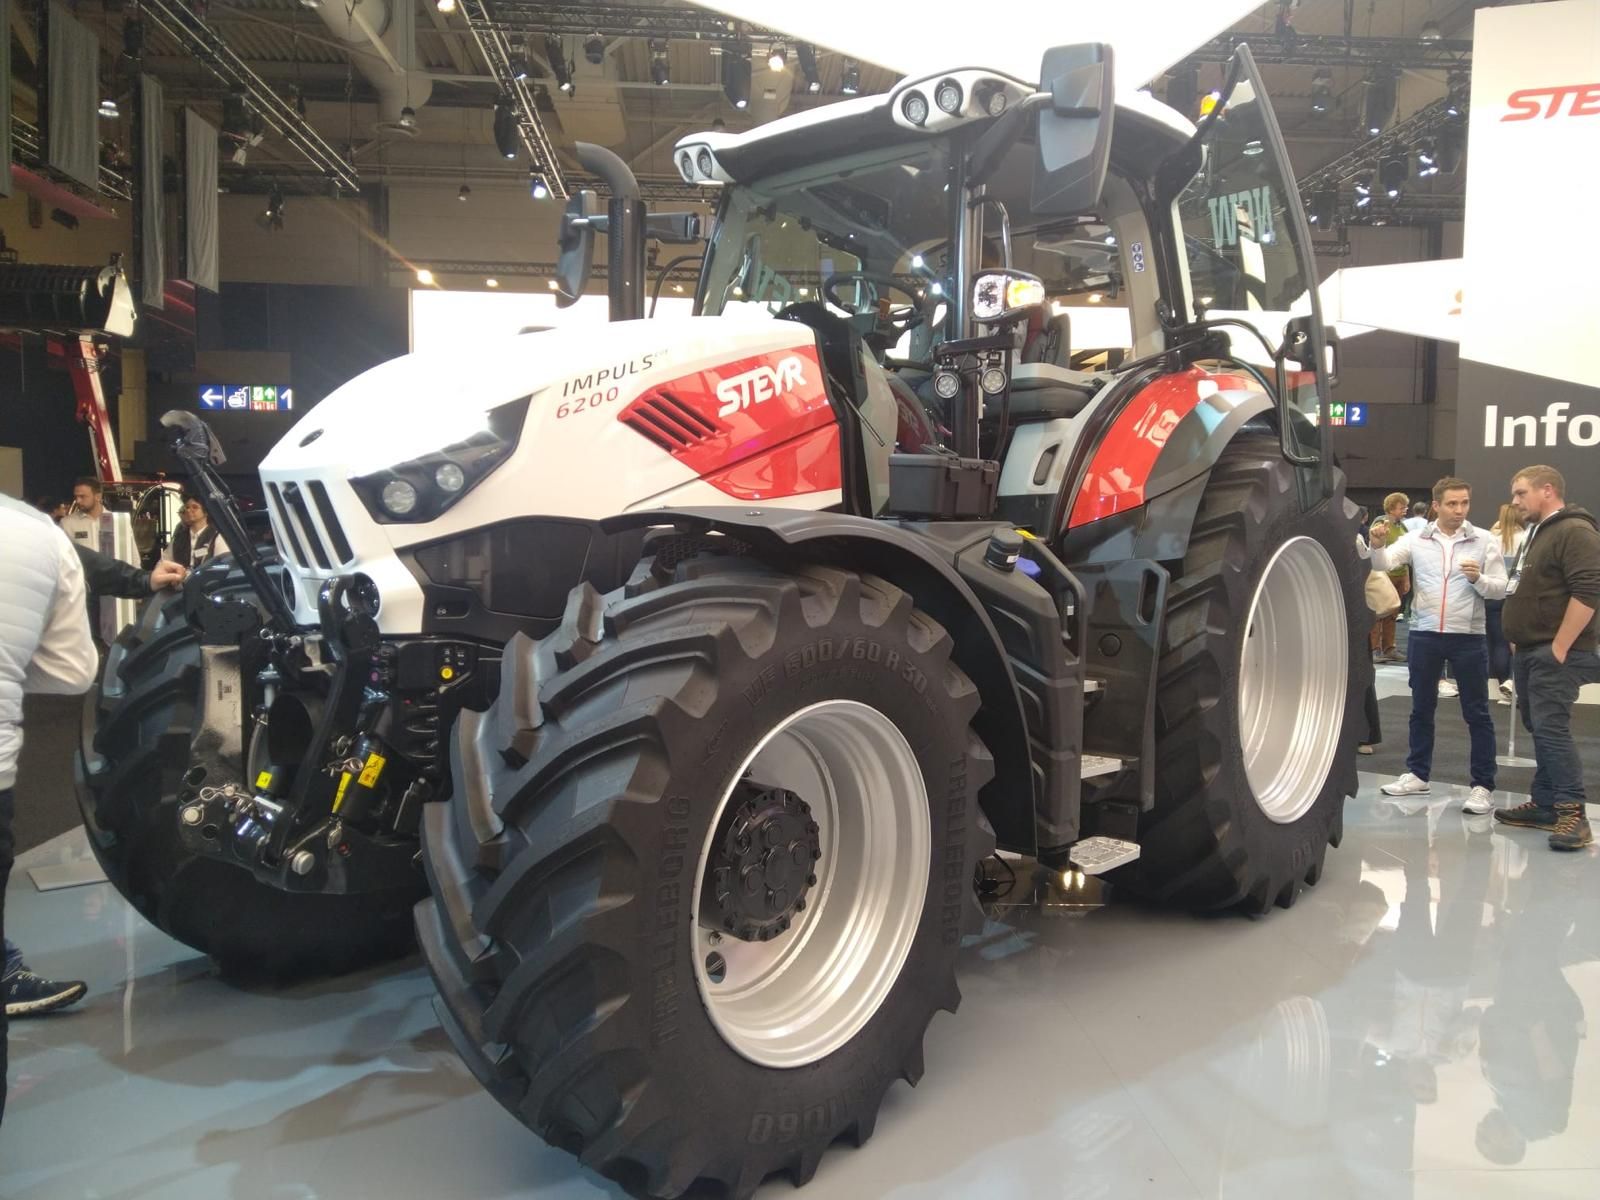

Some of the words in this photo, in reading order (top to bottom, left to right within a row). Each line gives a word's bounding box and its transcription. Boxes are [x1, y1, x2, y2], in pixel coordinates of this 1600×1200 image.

[1499, 83, 1600, 122] STE
[563, 354, 654, 397] IMPULS
[716, 356, 807, 418] STEYR
[280, 388, 292, 409] 1
[556, 386, 619, 419] 6200
[1351, 406, 1361, 421] 2
[1484, 402, 1600, 447] Info
[902, 661, 928, 694] 30
